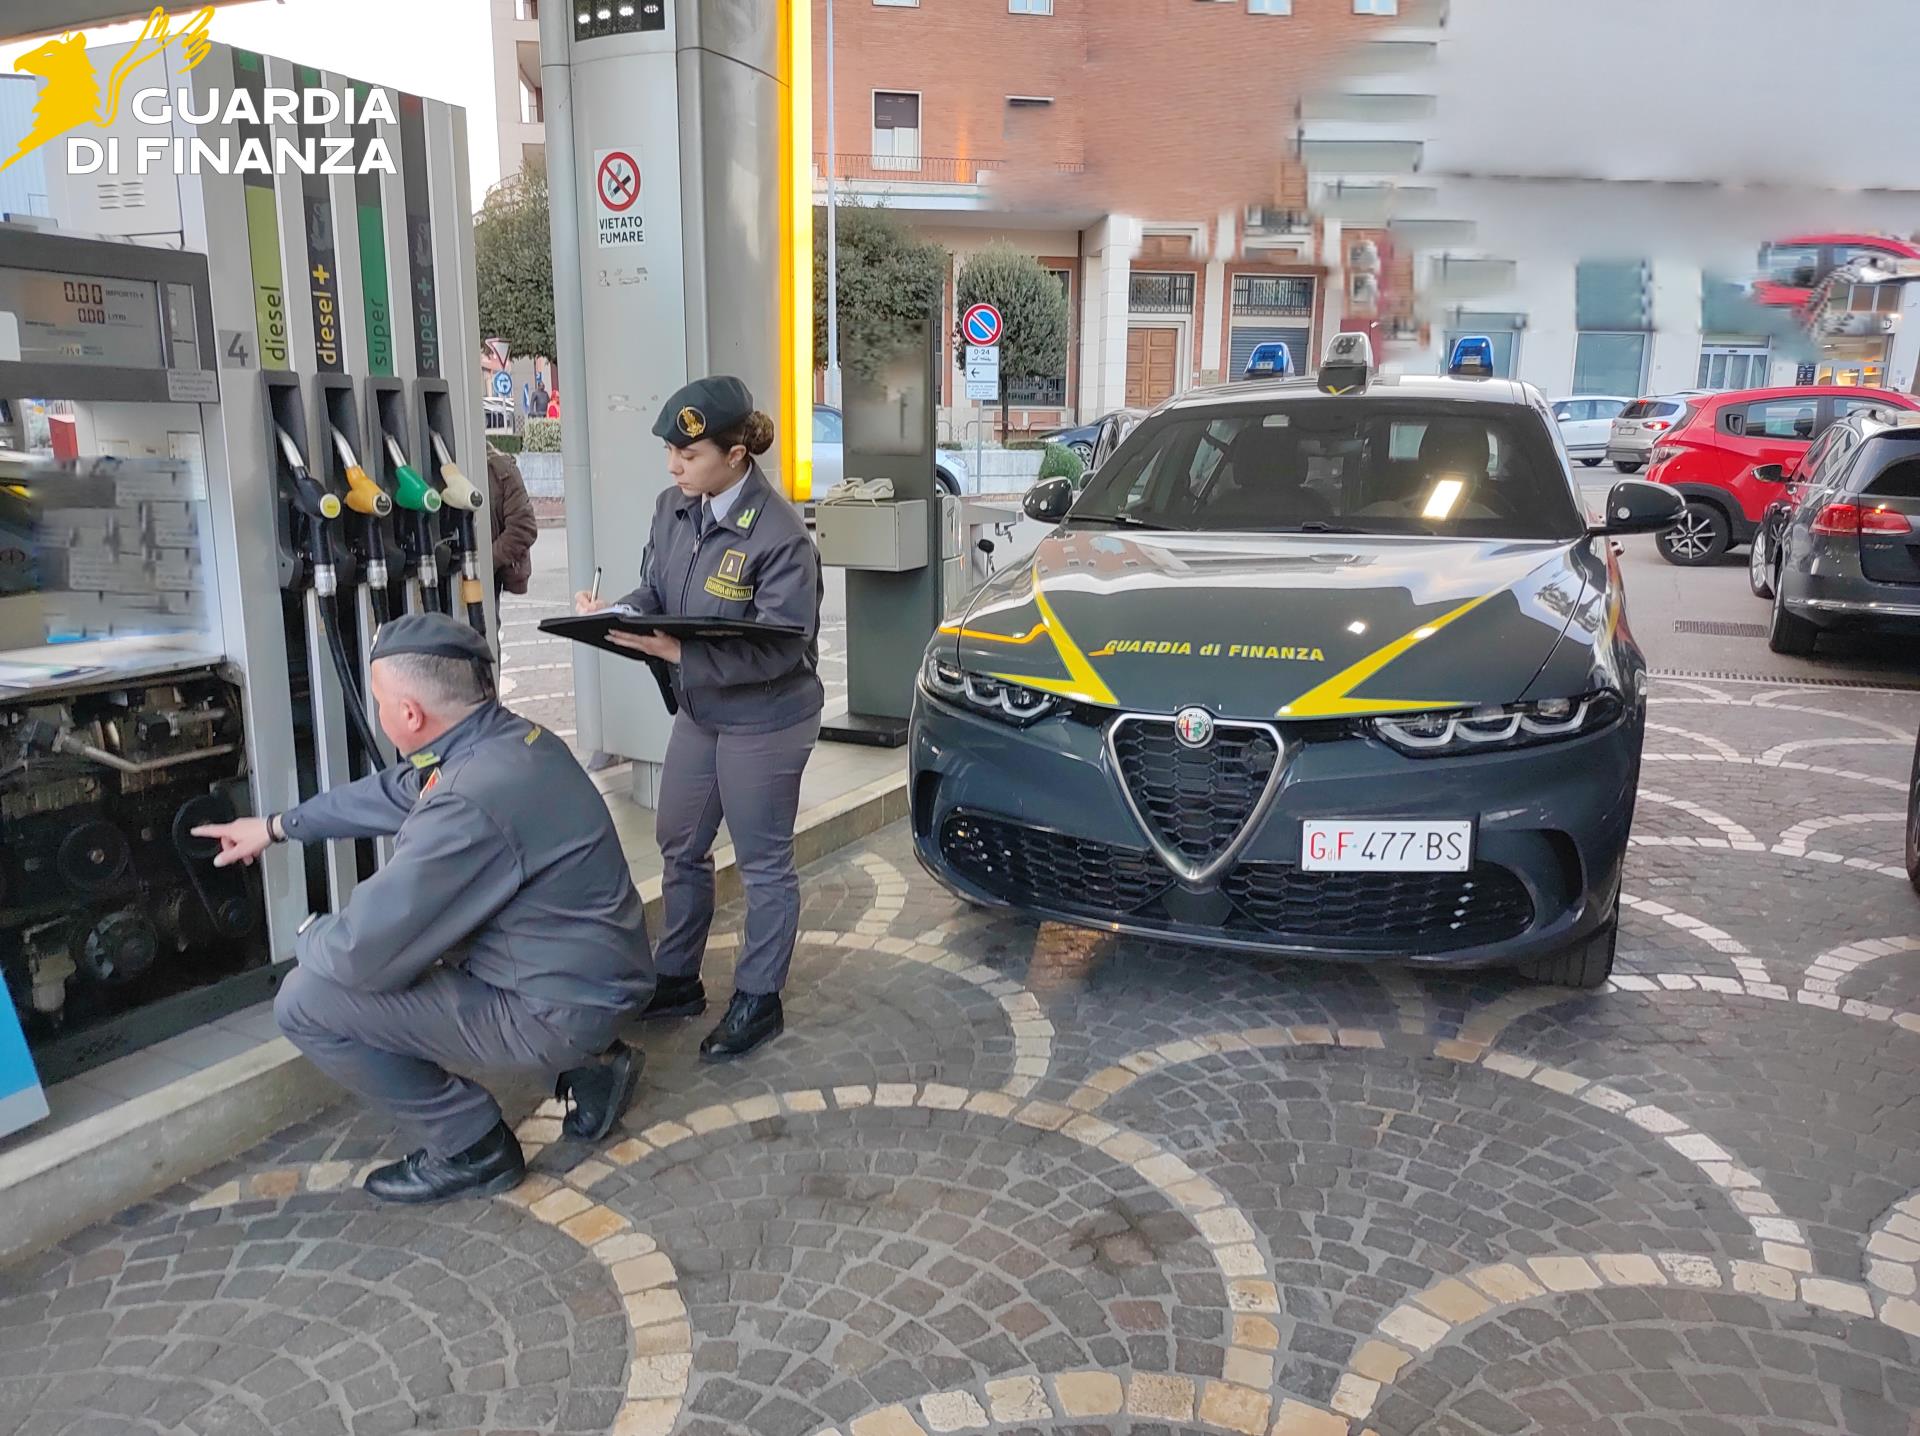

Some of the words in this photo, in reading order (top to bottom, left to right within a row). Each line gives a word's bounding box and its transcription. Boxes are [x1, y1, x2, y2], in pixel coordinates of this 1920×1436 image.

[599, 215, 643, 230] VIETATO
[600, 230, 645, 245] FUMARE
[63, 281, 104, 305] 0.00
[260, 285, 286, 361] diesel
[313, 290, 337, 365] diesel
[370, 297, 391, 366] super
[418, 303, 437, 370] super
[227, 332, 249, 367] 4
[1103, 639, 1192, 655] GUARDIA
[1199, 643, 1222, 656] di
[1228, 643, 1326, 662] FINANZA
